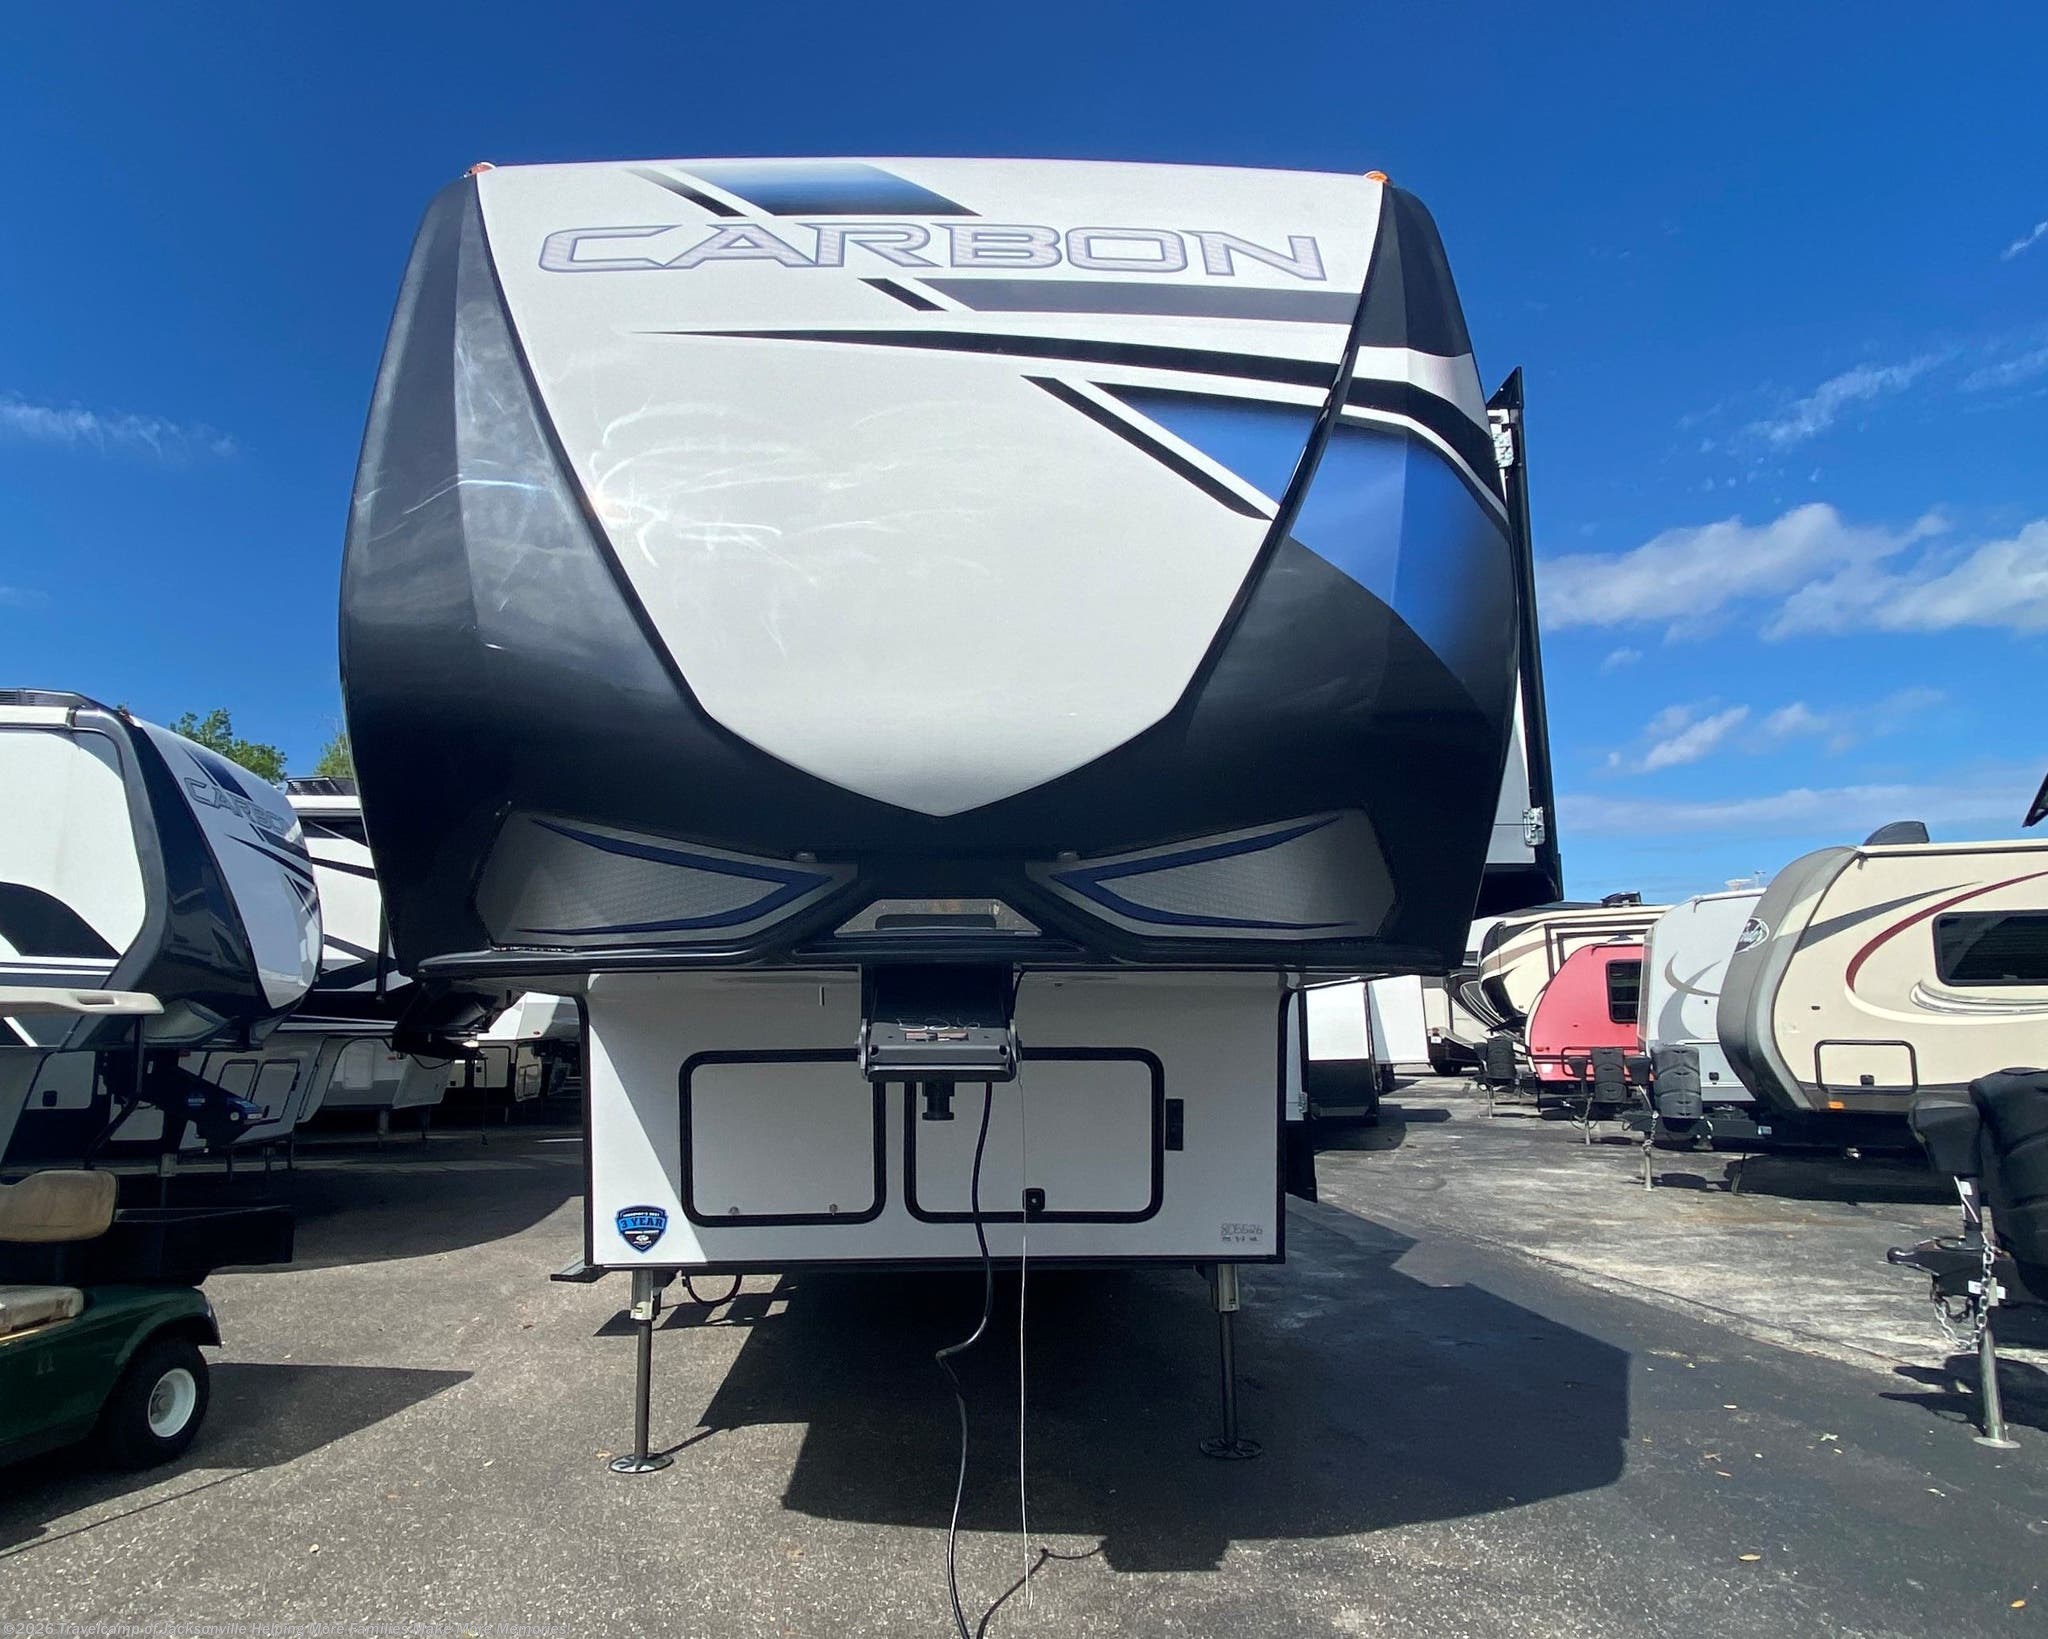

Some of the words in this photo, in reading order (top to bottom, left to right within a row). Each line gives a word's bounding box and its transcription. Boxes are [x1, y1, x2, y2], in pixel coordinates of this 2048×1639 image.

[538, 223, 1327, 281] CARBON
[184, 776, 287, 836] CARBO
[620, 1219, 628, 1229] 3
[631, 1217, 663, 1228] YEAR
